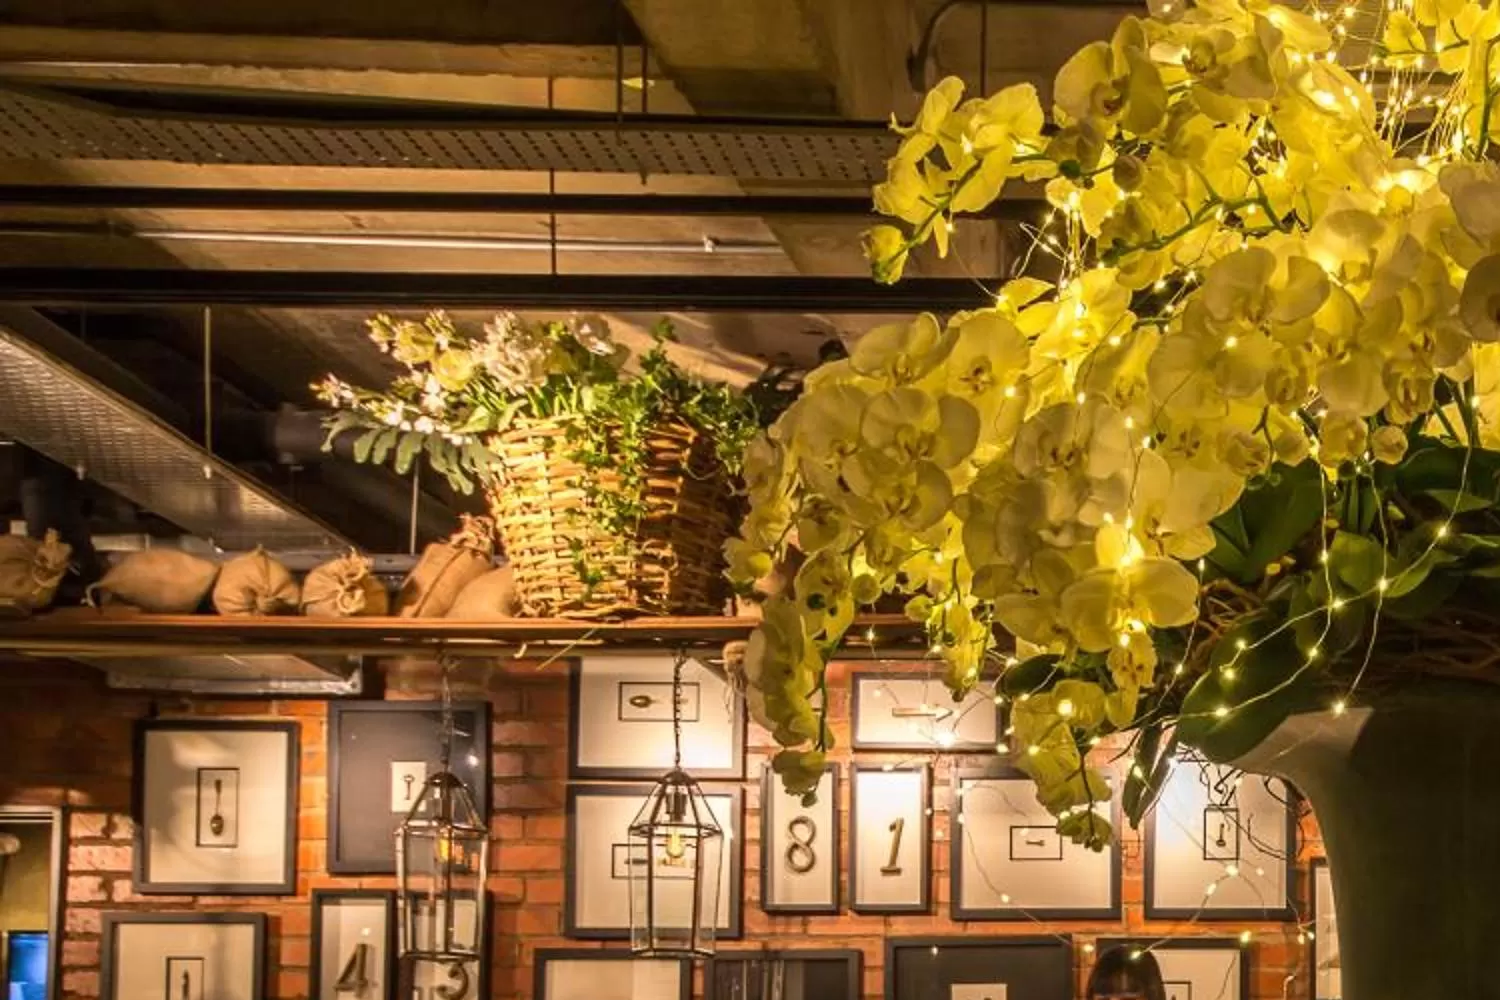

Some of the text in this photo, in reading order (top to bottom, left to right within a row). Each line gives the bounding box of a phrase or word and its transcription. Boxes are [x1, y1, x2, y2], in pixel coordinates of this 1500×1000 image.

[783, 815, 818, 874] 8
[879, 817, 905, 876] 1
[333, 942, 370, 1000] 4
